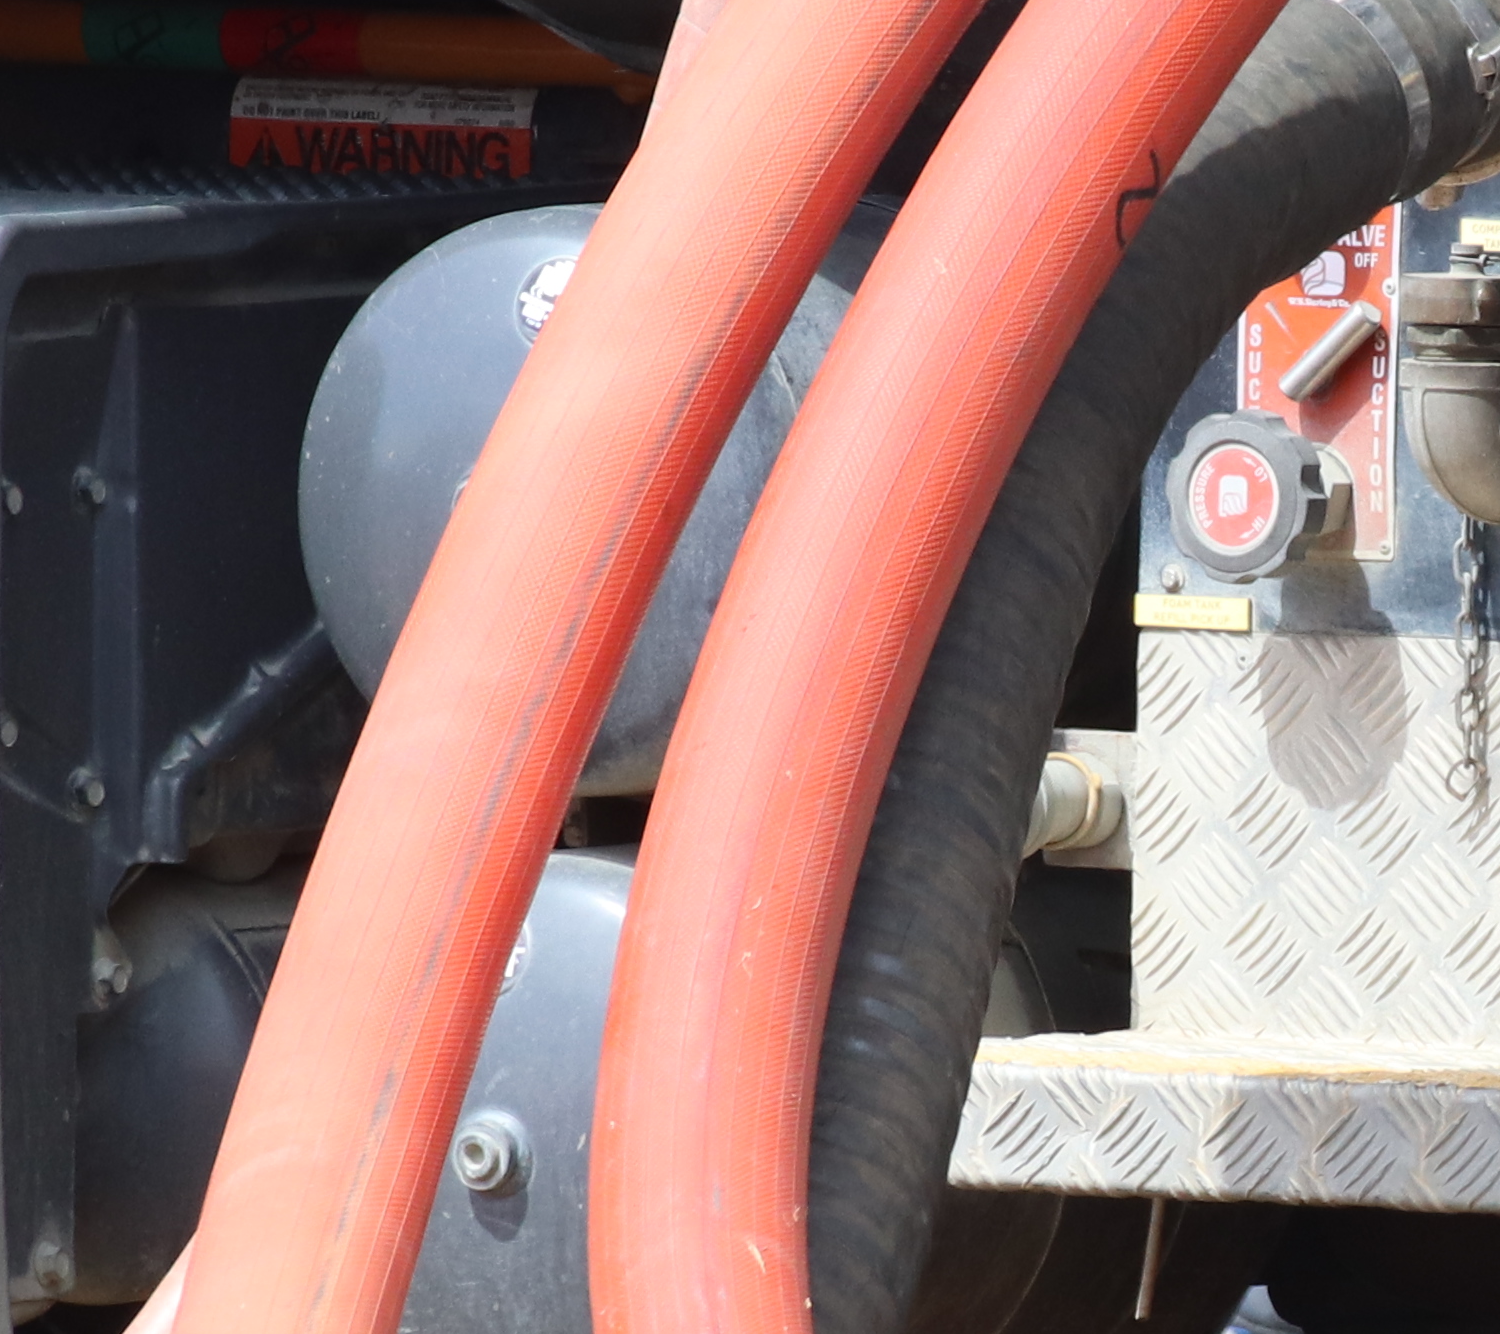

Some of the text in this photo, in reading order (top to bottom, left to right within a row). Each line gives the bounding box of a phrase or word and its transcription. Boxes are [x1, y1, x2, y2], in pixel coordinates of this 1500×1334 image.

[296, 125, 513, 176] WARNING
[1353, 253, 1379, 269] OFF
[1369, 331, 1387, 514] SUCTION
[1192, 462, 1215, 531] PRESSURE
[1161, 598, 1222, 611] FOAM TANK
